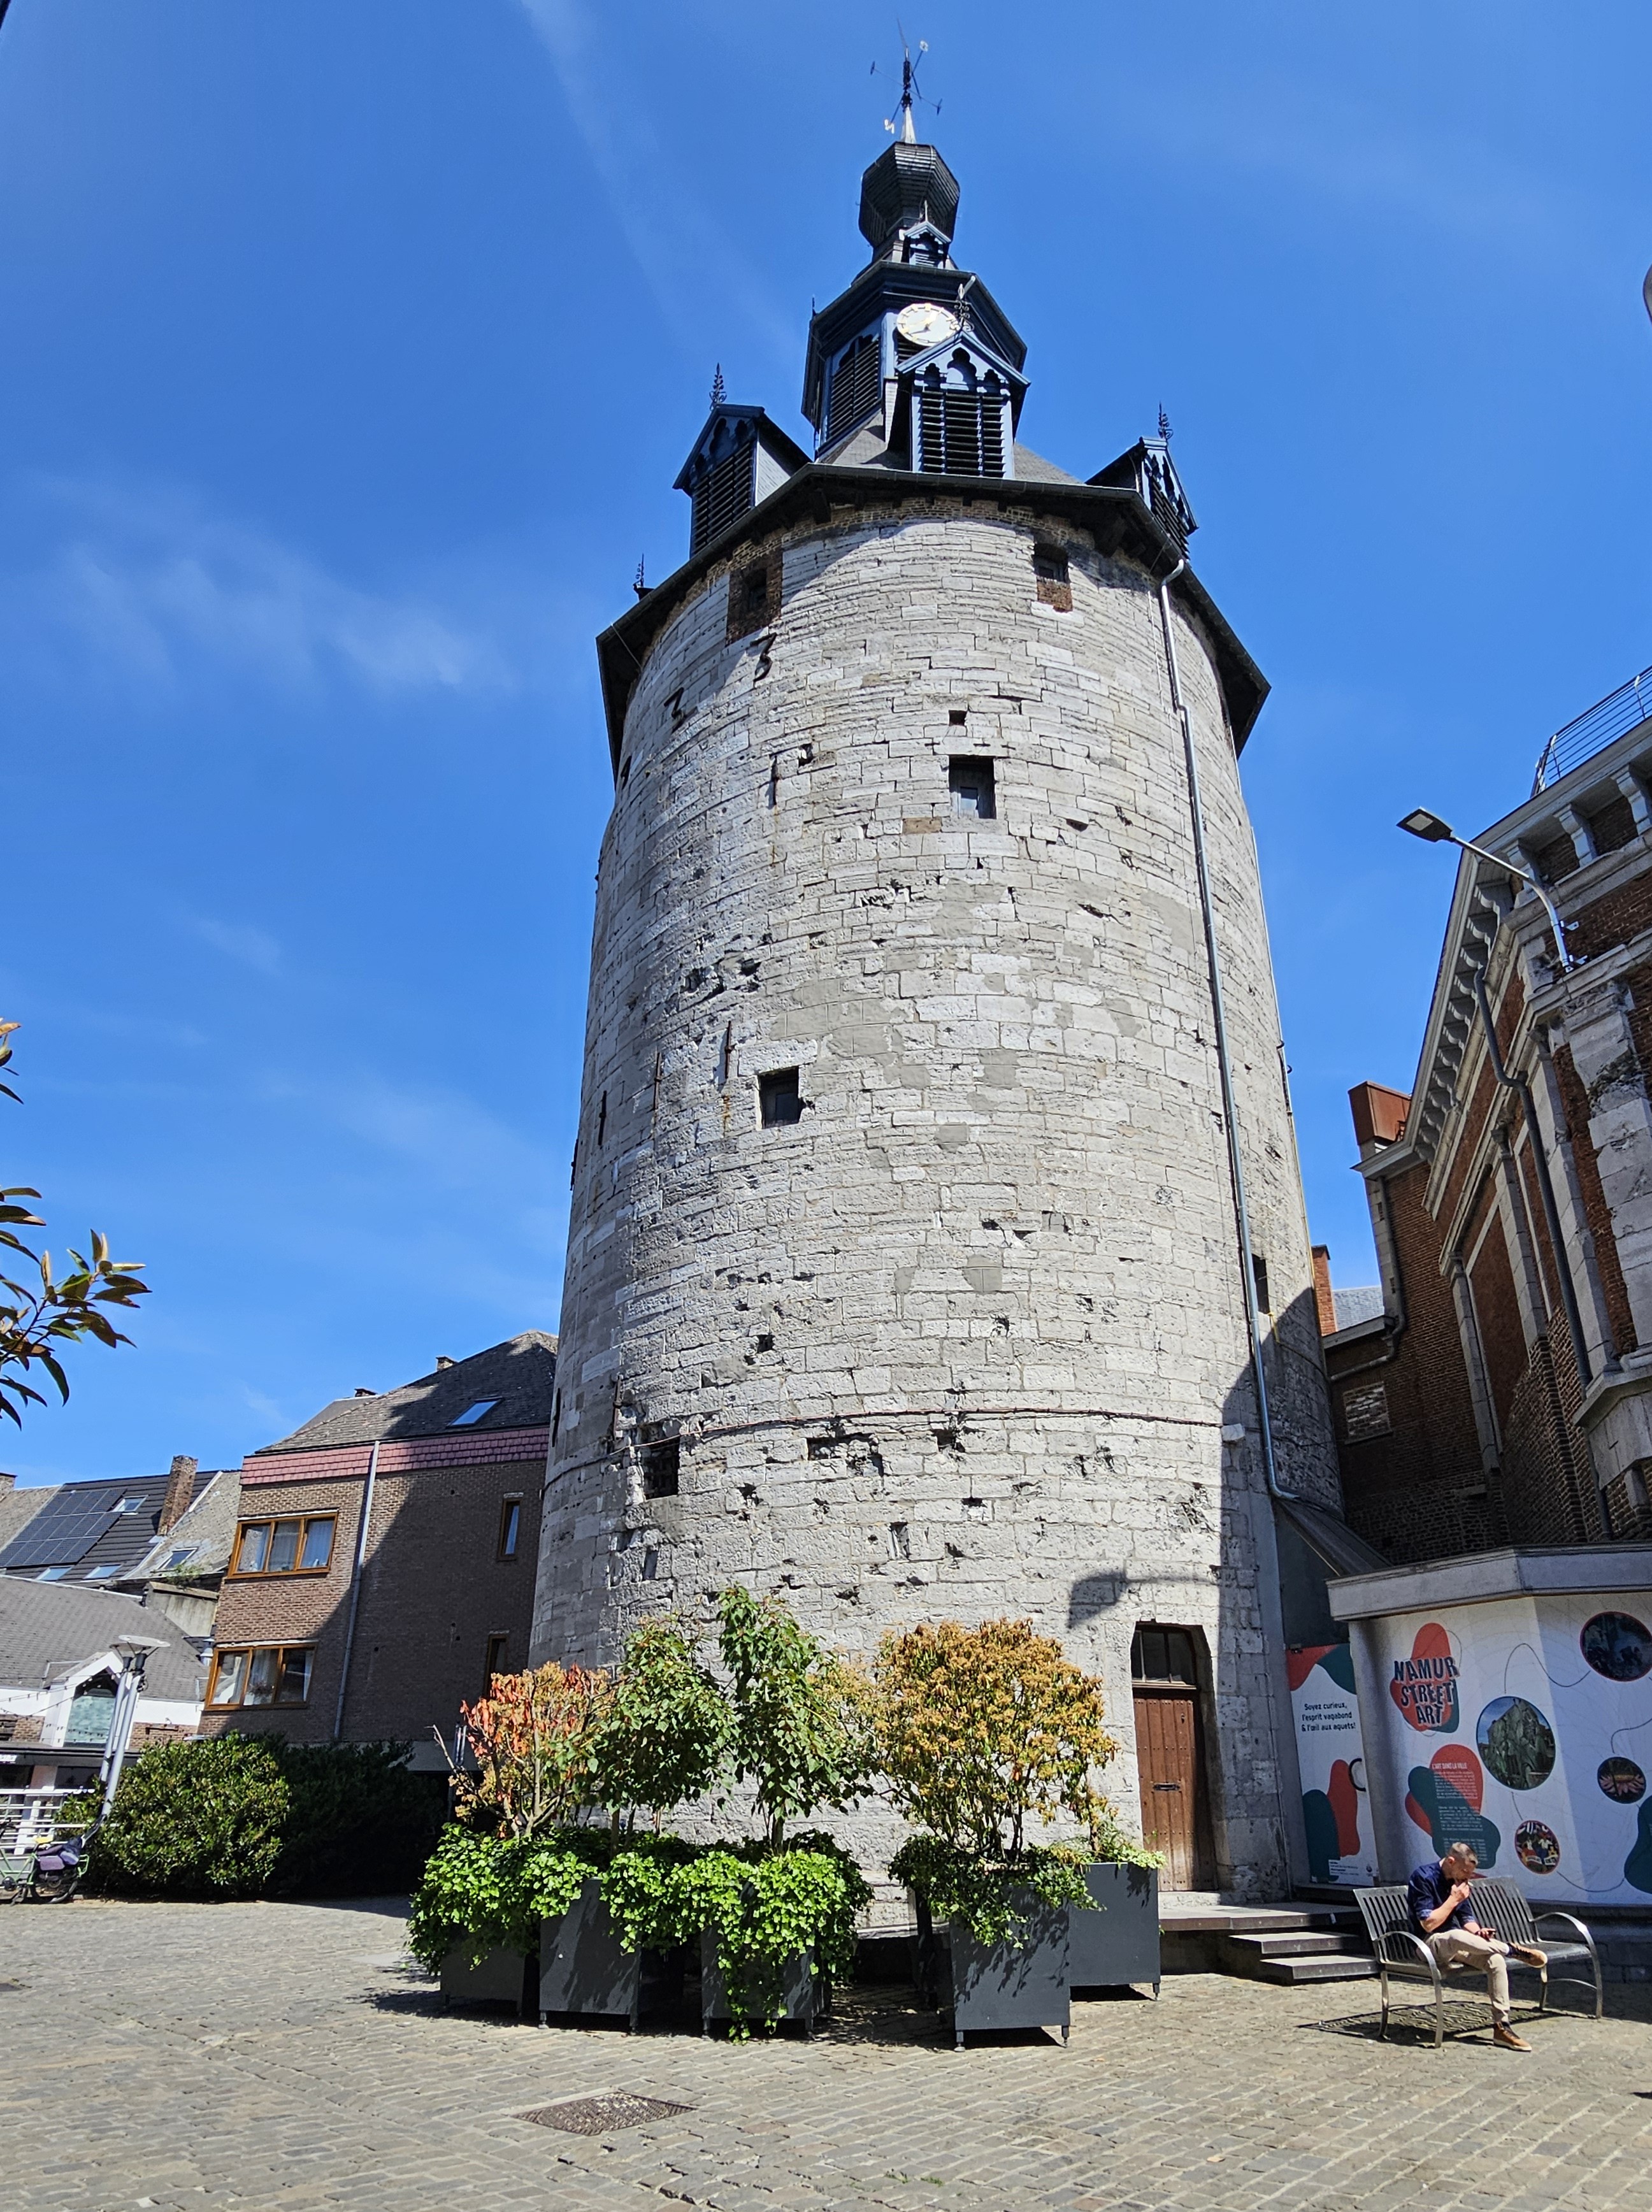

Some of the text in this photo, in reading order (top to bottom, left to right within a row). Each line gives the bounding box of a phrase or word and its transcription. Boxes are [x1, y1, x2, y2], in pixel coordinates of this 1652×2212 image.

[1394, 1656, 1460, 1681] NAMUR
[1401, 1683, 1453, 1706] STREET
[1302, 1711, 1352, 1721] l'esprit vagabond
[1416, 1704, 1443, 1724] ART
